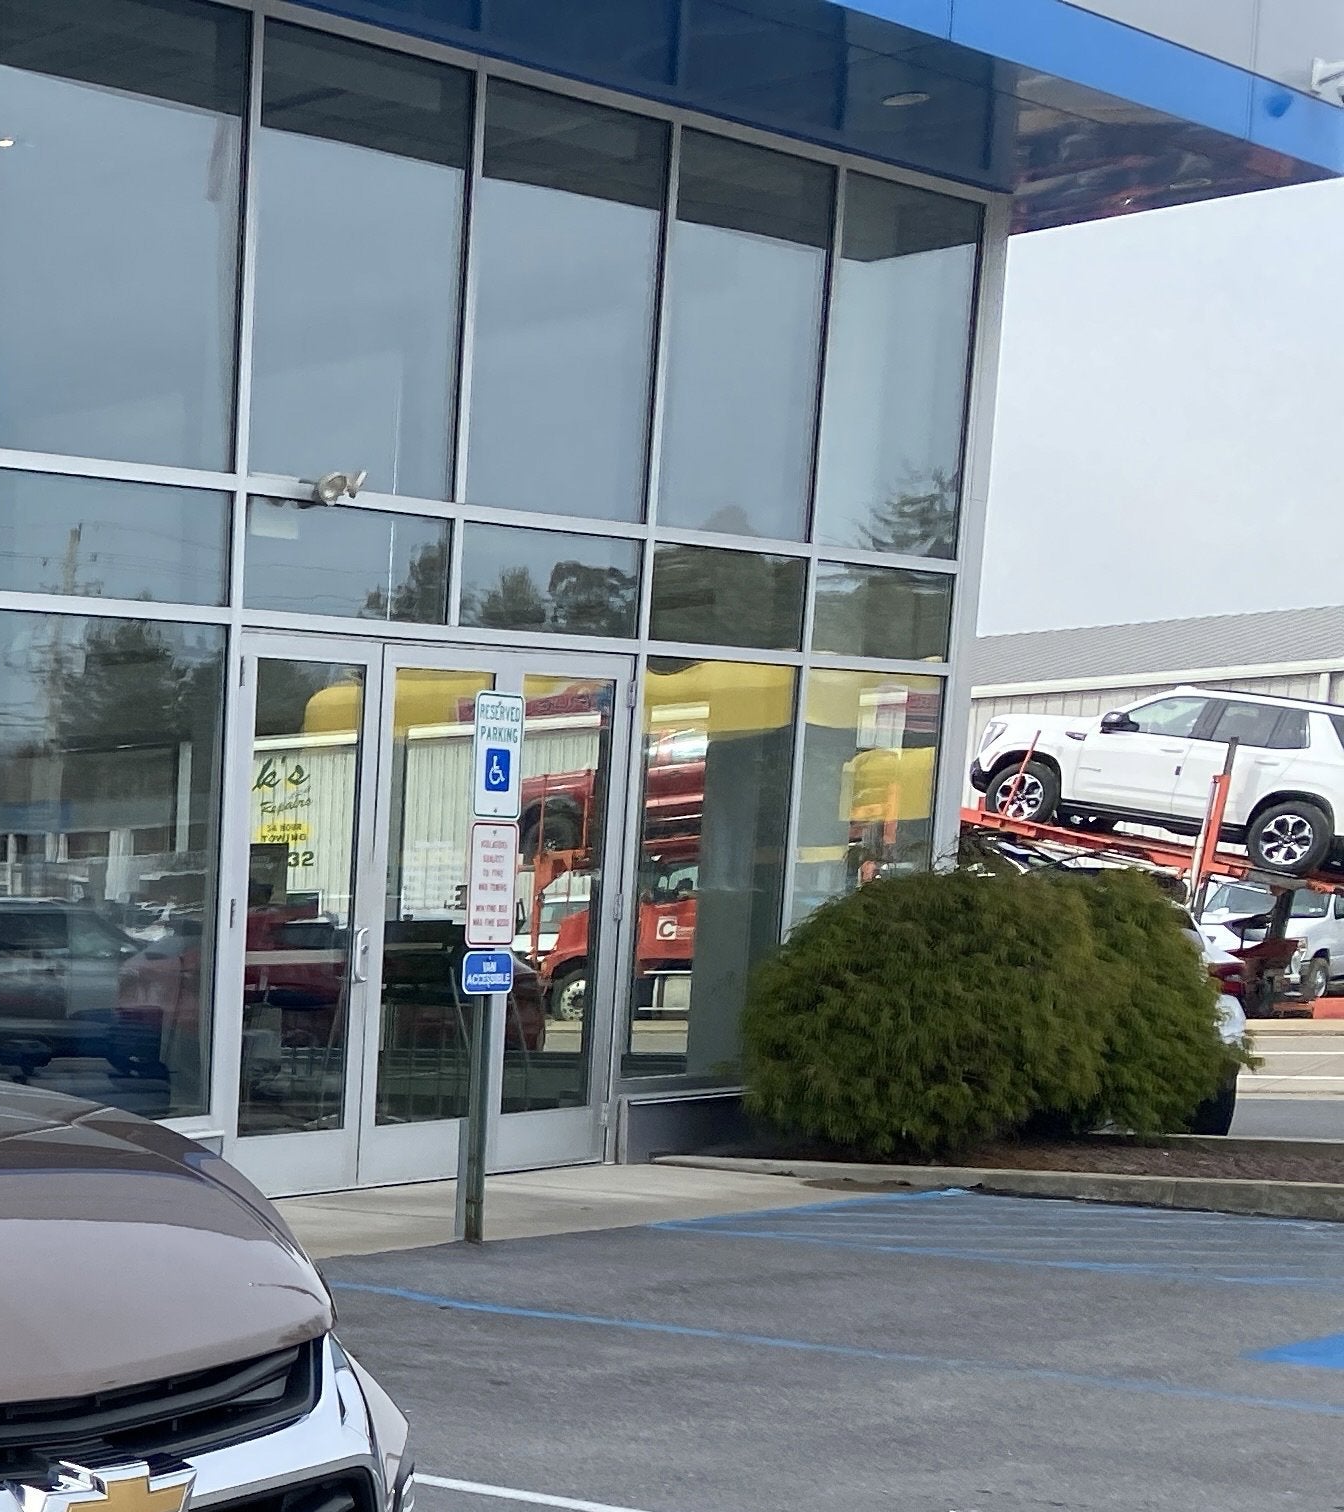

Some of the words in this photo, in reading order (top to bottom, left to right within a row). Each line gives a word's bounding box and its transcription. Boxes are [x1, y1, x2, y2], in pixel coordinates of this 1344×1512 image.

[480, 704, 520, 722] RESERVED
[480, 726, 518, 743] PARKING
[280, 823, 302, 832] HOUR
[260, 834, 307, 843] TOWING
[466, 973, 511, 986] ACCESSIBLE
